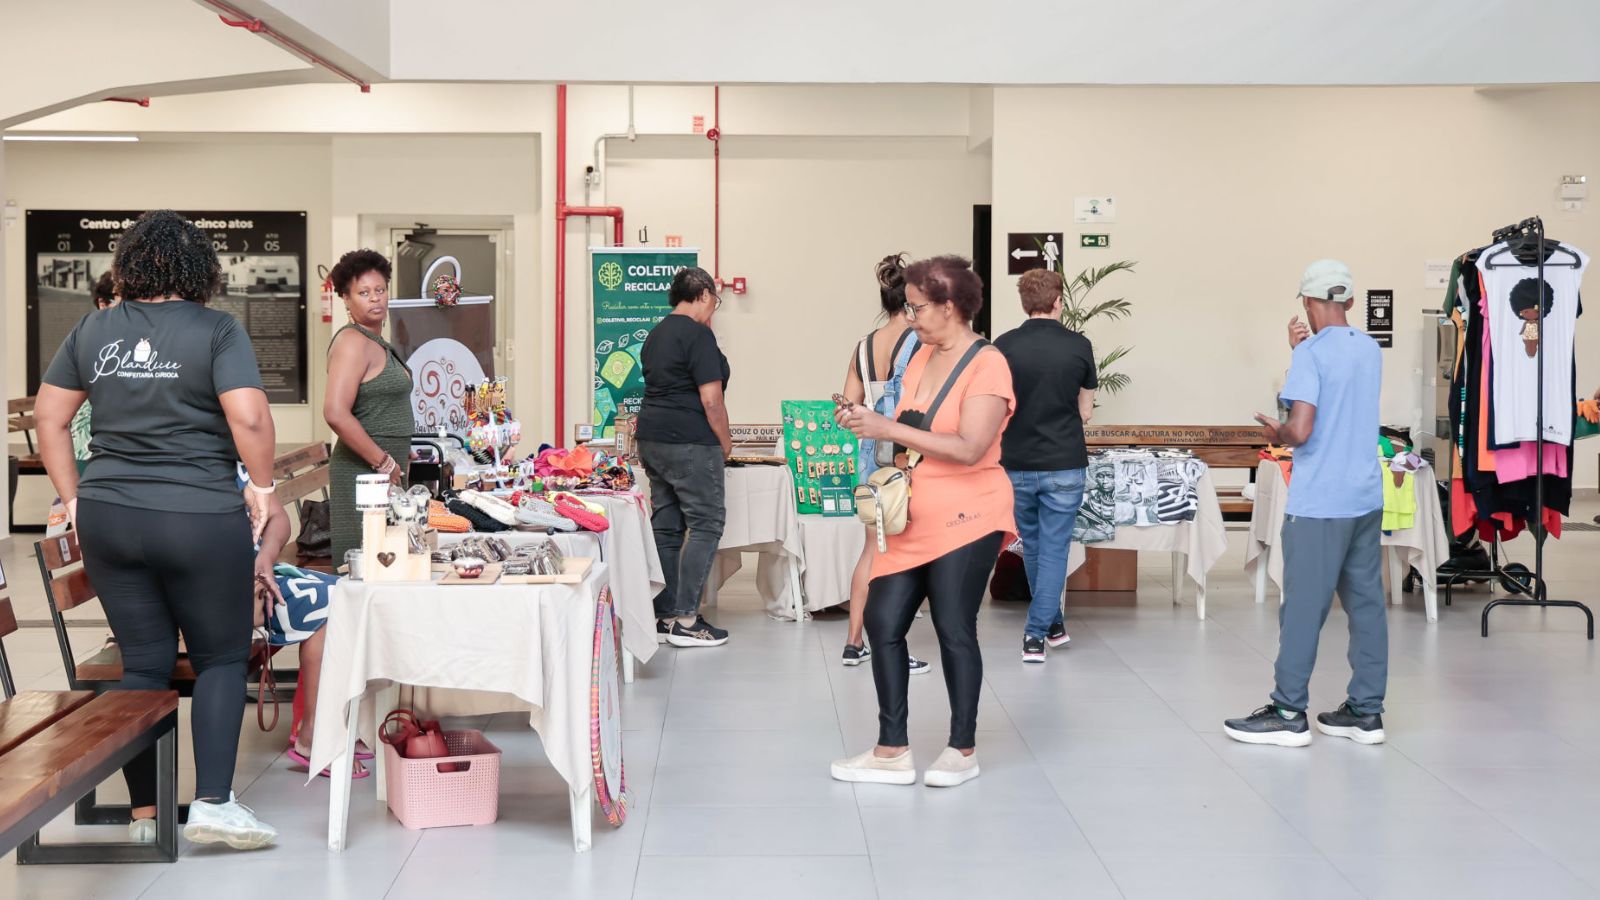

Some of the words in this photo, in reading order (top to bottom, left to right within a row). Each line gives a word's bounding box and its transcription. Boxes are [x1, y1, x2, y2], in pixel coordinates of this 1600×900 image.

[80, 218, 121, 229] Centro
[194, 218, 227, 229] cinco
[228, 219, 254, 229] atos
[57, 240, 71, 252] 01
[212, 240, 229, 252] 04
[263, 240, 281, 252] 05
[624, 282, 673, 291] RECICLAA
[116, 370, 154, 379] CONFEITARIA
[155, 371, 179, 379] CARIOCA
[760, 428, 774, 436] QUE
[1084, 430, 1099, 438] QUE
[1138, 430, 1170, 438] CULTURA
[1208, 430, 1235, 438] DANDO
